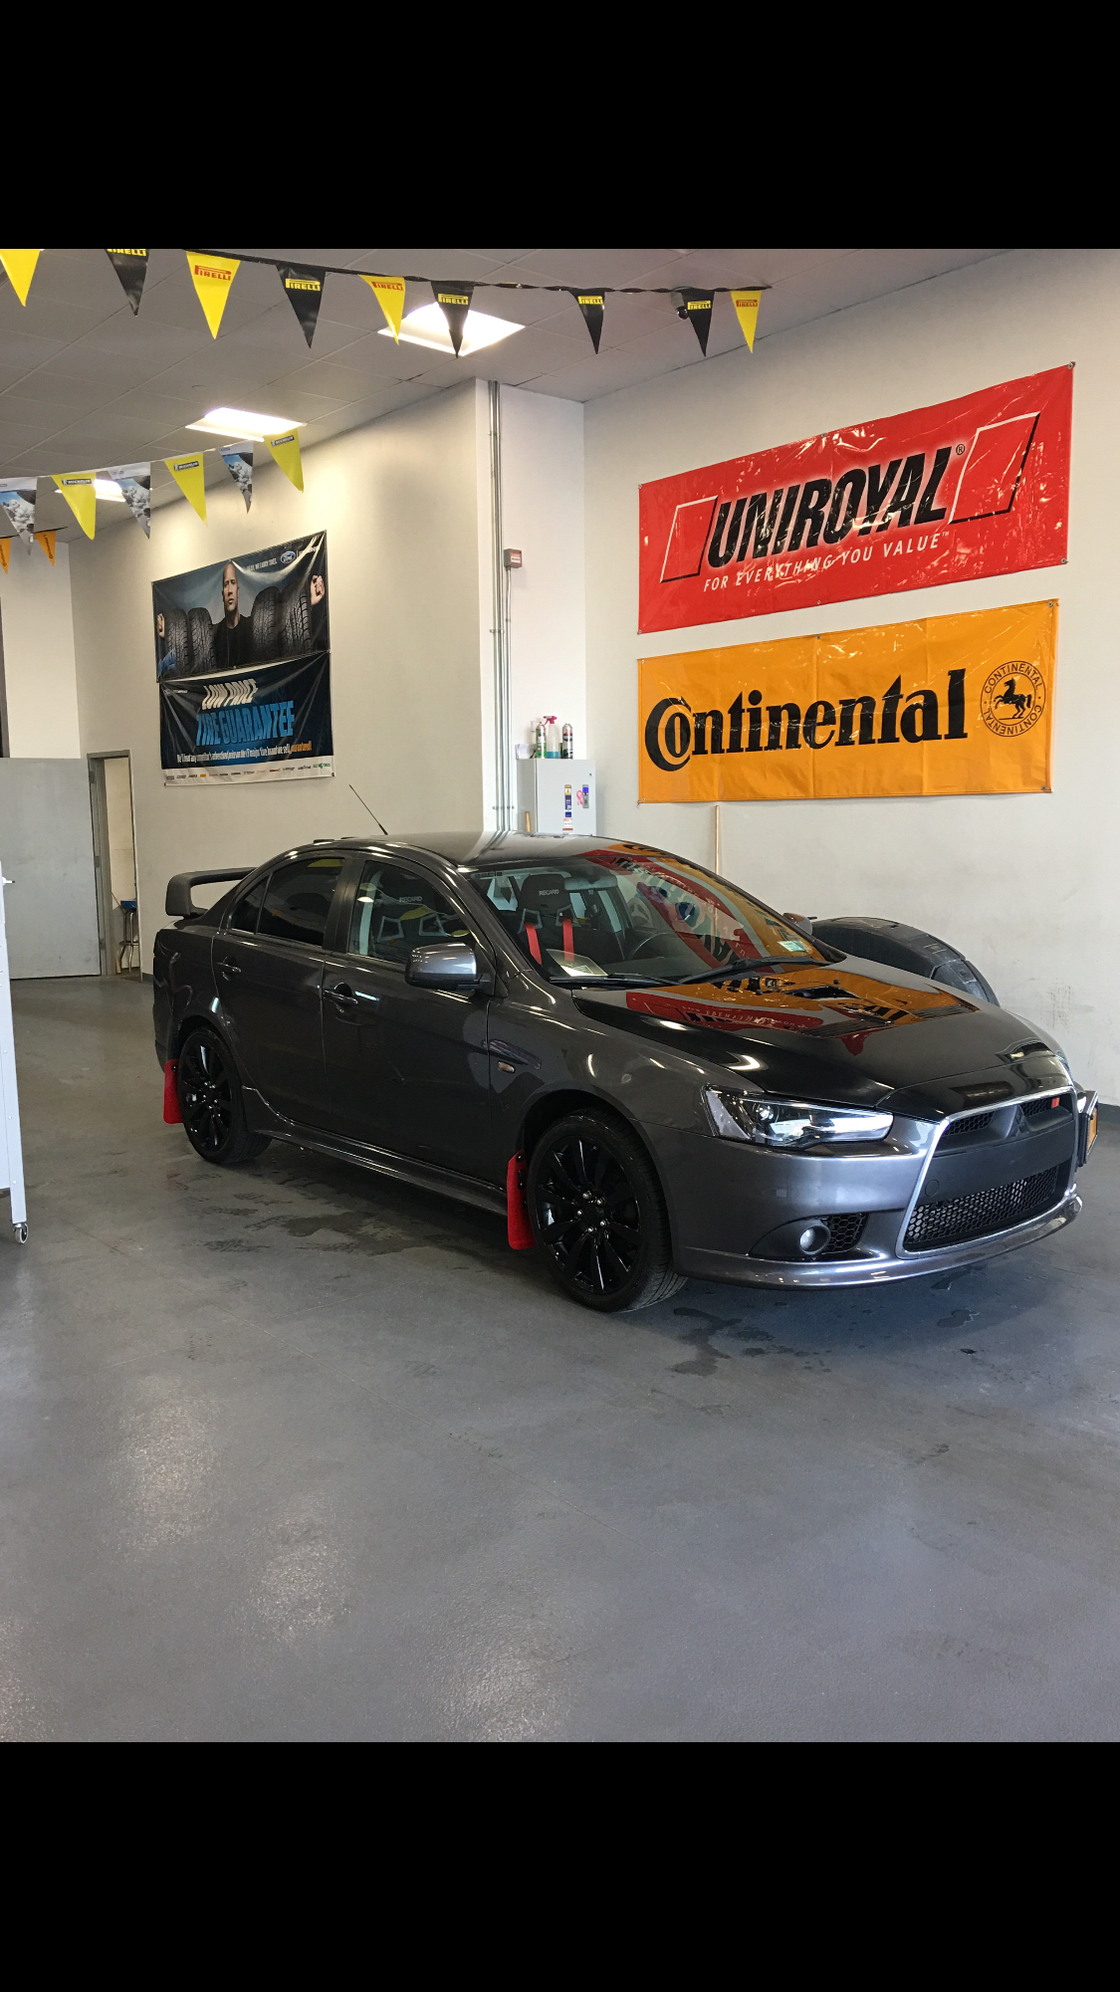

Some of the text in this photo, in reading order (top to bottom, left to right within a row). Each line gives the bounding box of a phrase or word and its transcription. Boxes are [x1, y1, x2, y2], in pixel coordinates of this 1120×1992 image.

[194, 265, 232, 281] PIRELLI
[285, 278, 321, 292] PIRELLI
[371, 281, 404, 291] PIRELLI
[437, 293, 469, 305] PIRELLI
[578, 295, 603, 305] PIRELLI
[687, 300, 711, 310] PIRELLI
[736, 299, 758, 307] PIRELLI
[707, 446, 952, 568] UNIROYAL
[704, 575, 728, 592] FOR
[735, 553, 834, 587] EVERYTHING
[840, 546, 873, 566] YOU
[984, 662, 1043, 694] CONTINENTAL
[202, 678, 258, 710] LOW PRICE
[196, 700, 295, 746] TIRE GUARANTEE
[645, 668, 968, 771] Continental
[983, 704, 1042, 735] CONTINENTAL
